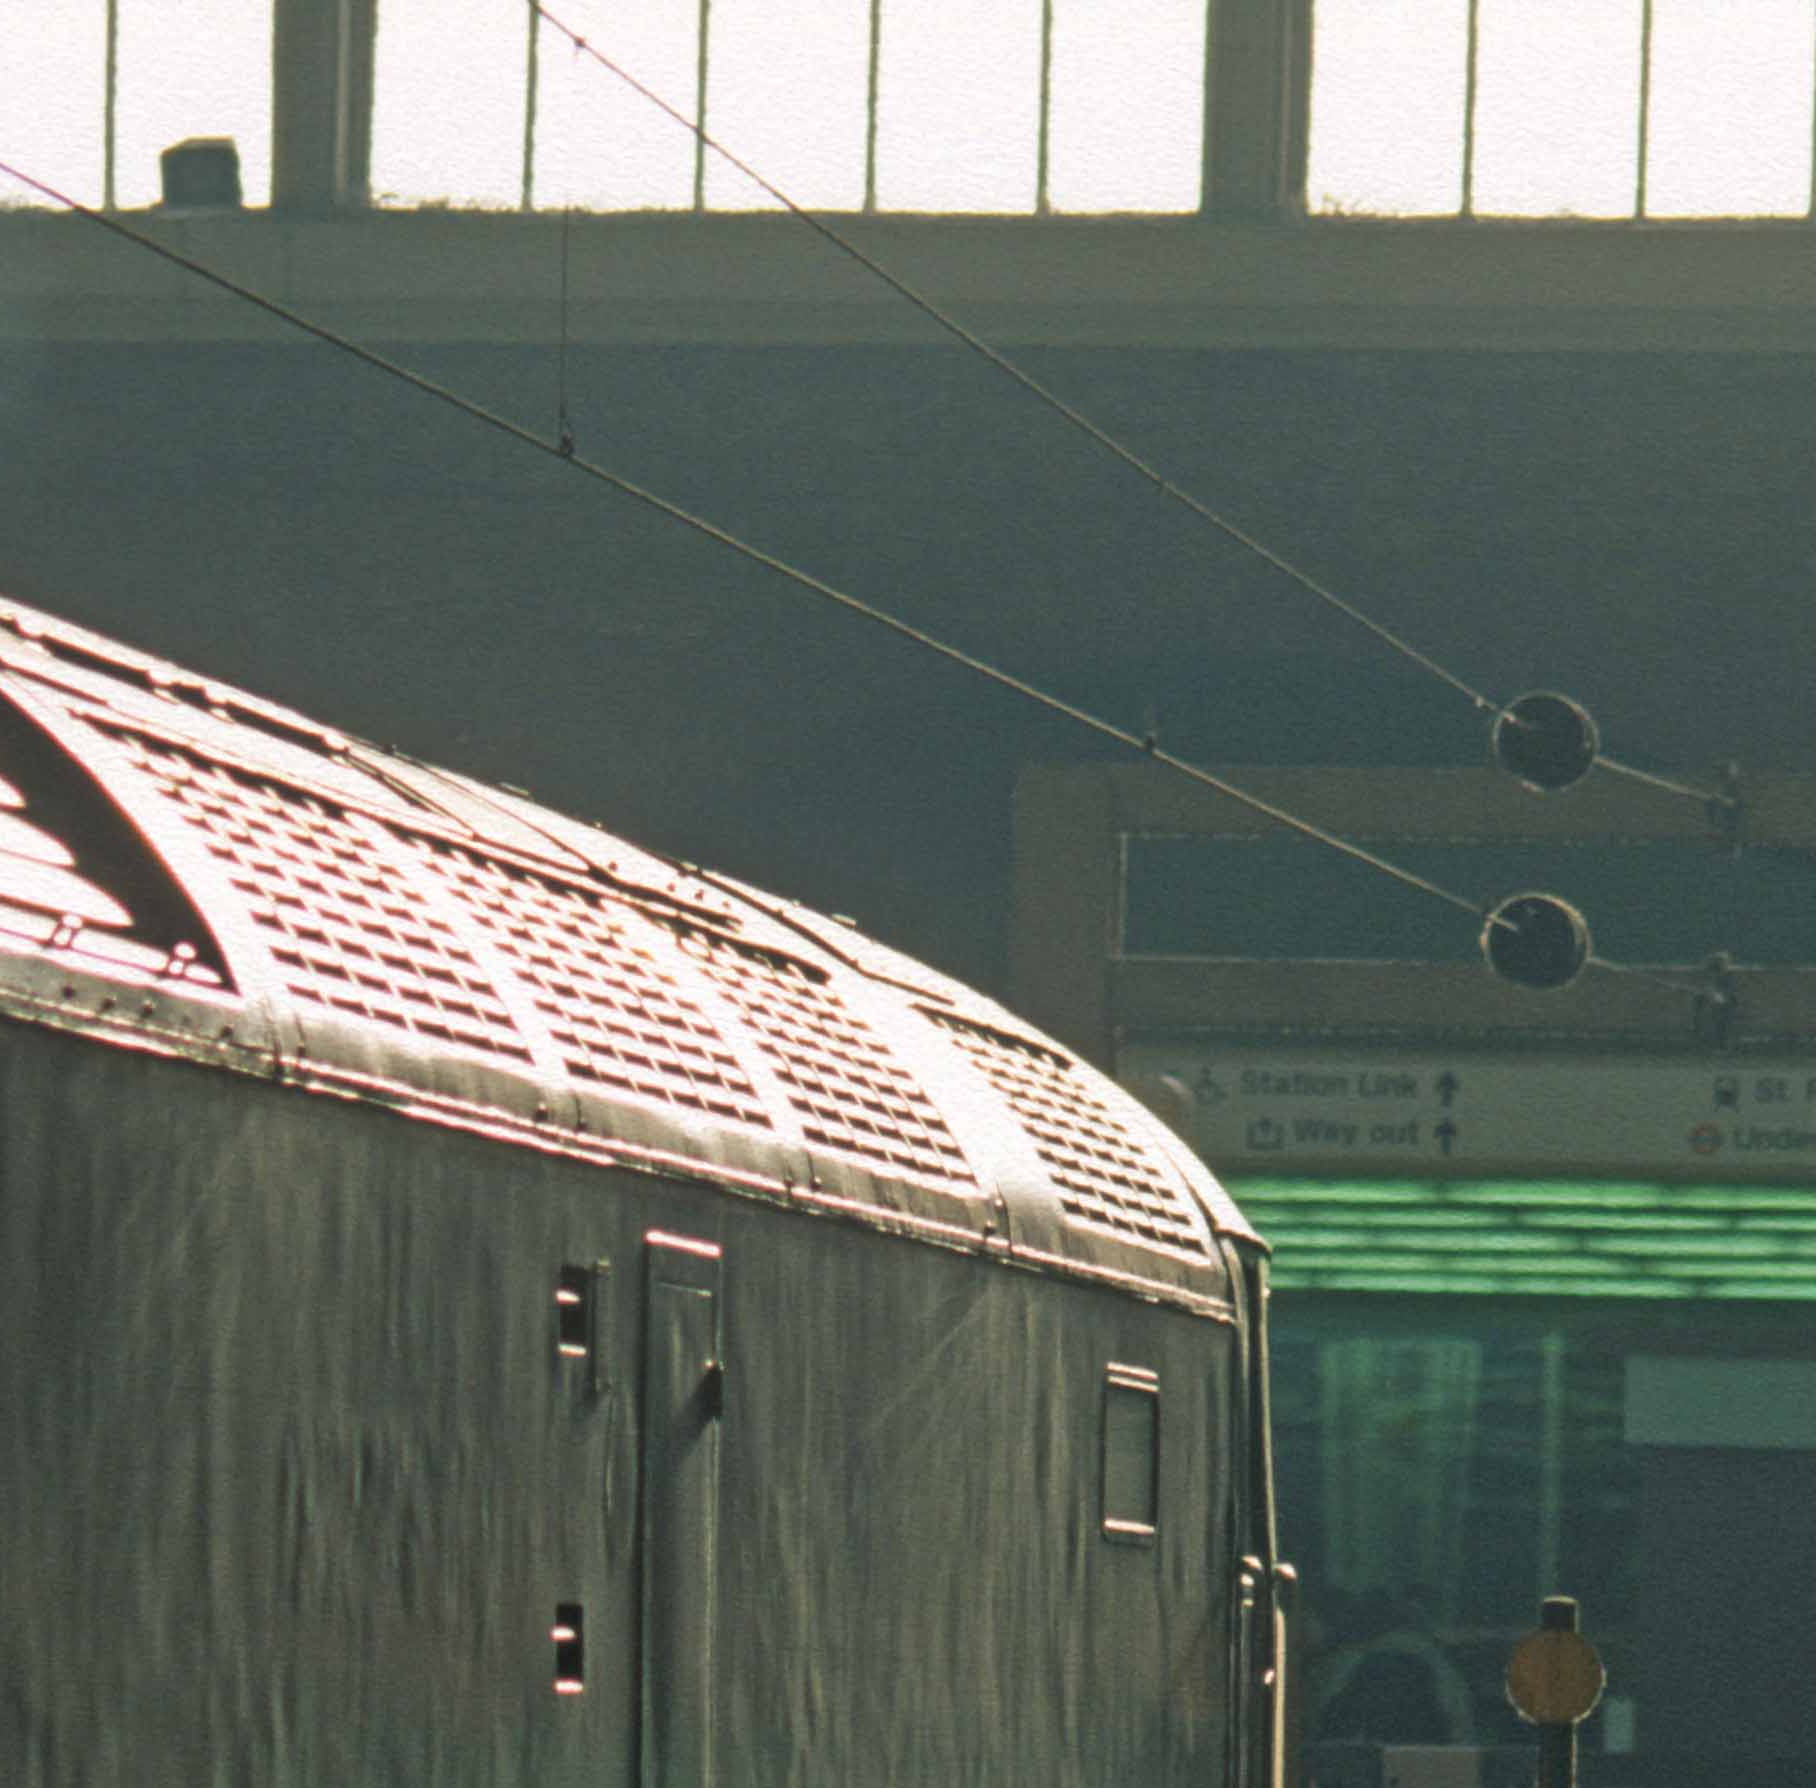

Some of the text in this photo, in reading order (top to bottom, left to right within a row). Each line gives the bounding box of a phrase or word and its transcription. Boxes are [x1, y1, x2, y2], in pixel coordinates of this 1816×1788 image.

[1240, 1069, 1417, 1099] Station Link
[1293, 1119, 1420, 1146] Way out
